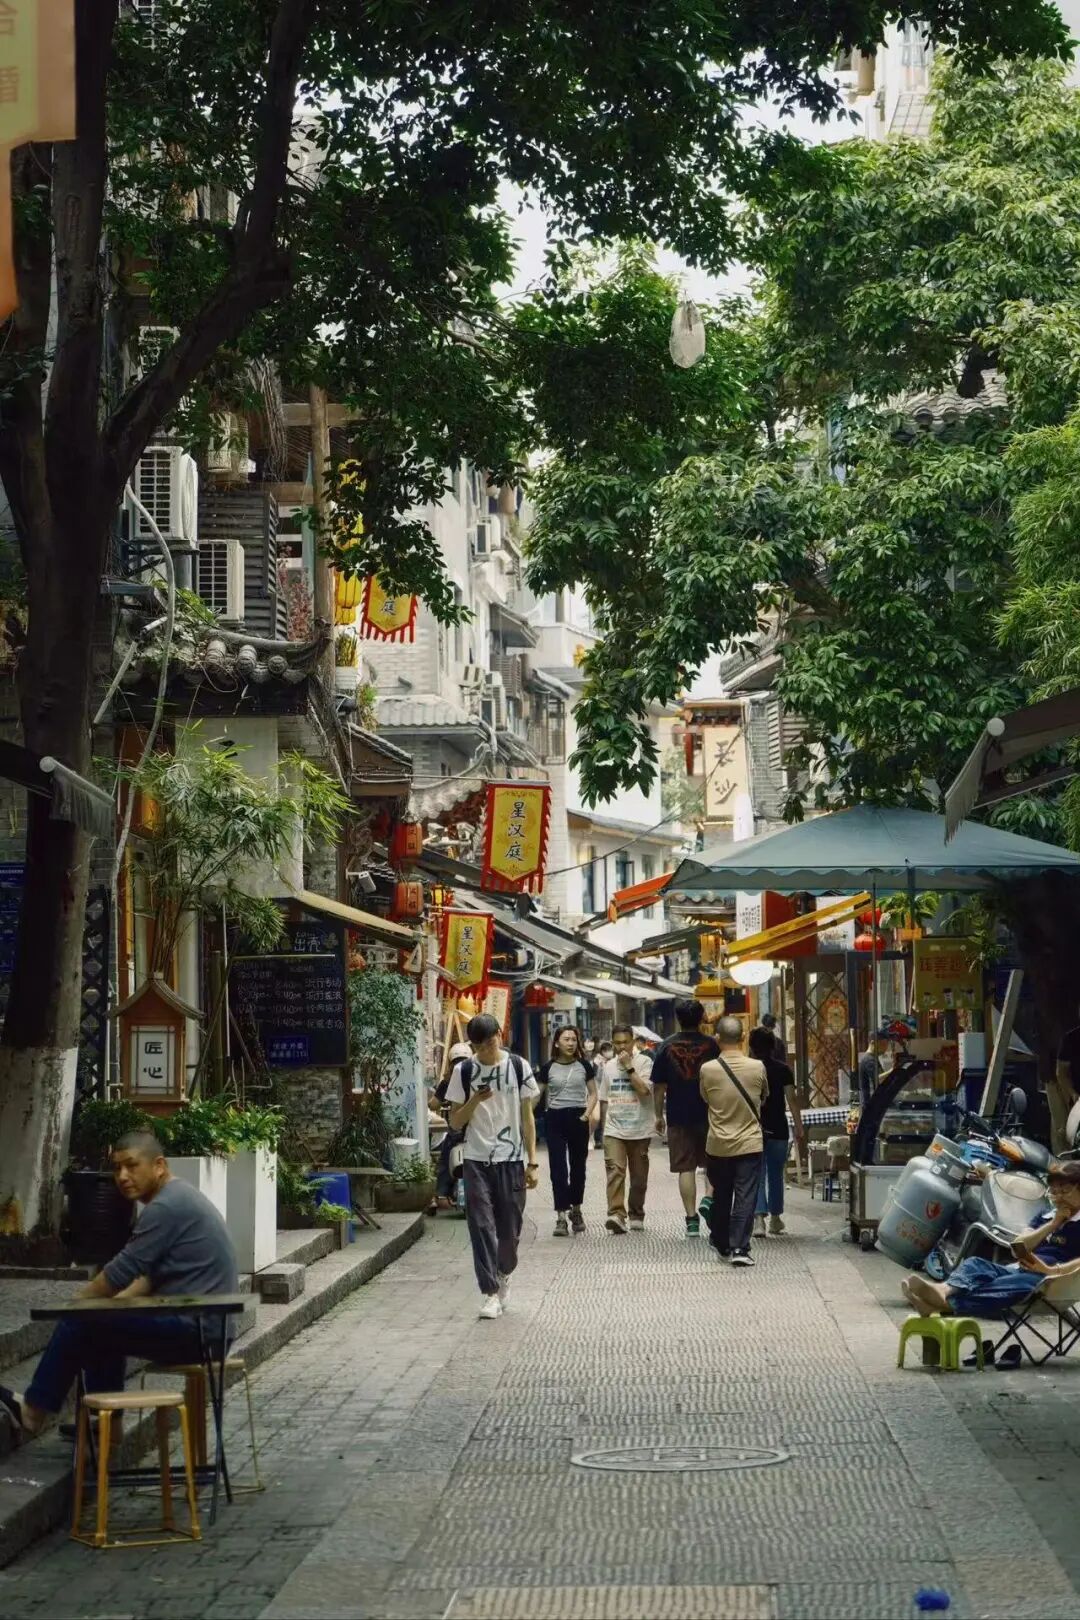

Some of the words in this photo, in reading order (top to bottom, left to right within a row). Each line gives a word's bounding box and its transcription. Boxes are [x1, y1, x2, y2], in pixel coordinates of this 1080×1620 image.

[505, 801, 526, 861] 星汉庭
[457, 925, 473, 975] 星汉庭
[143, 1041, 164, 1079] 匠心
